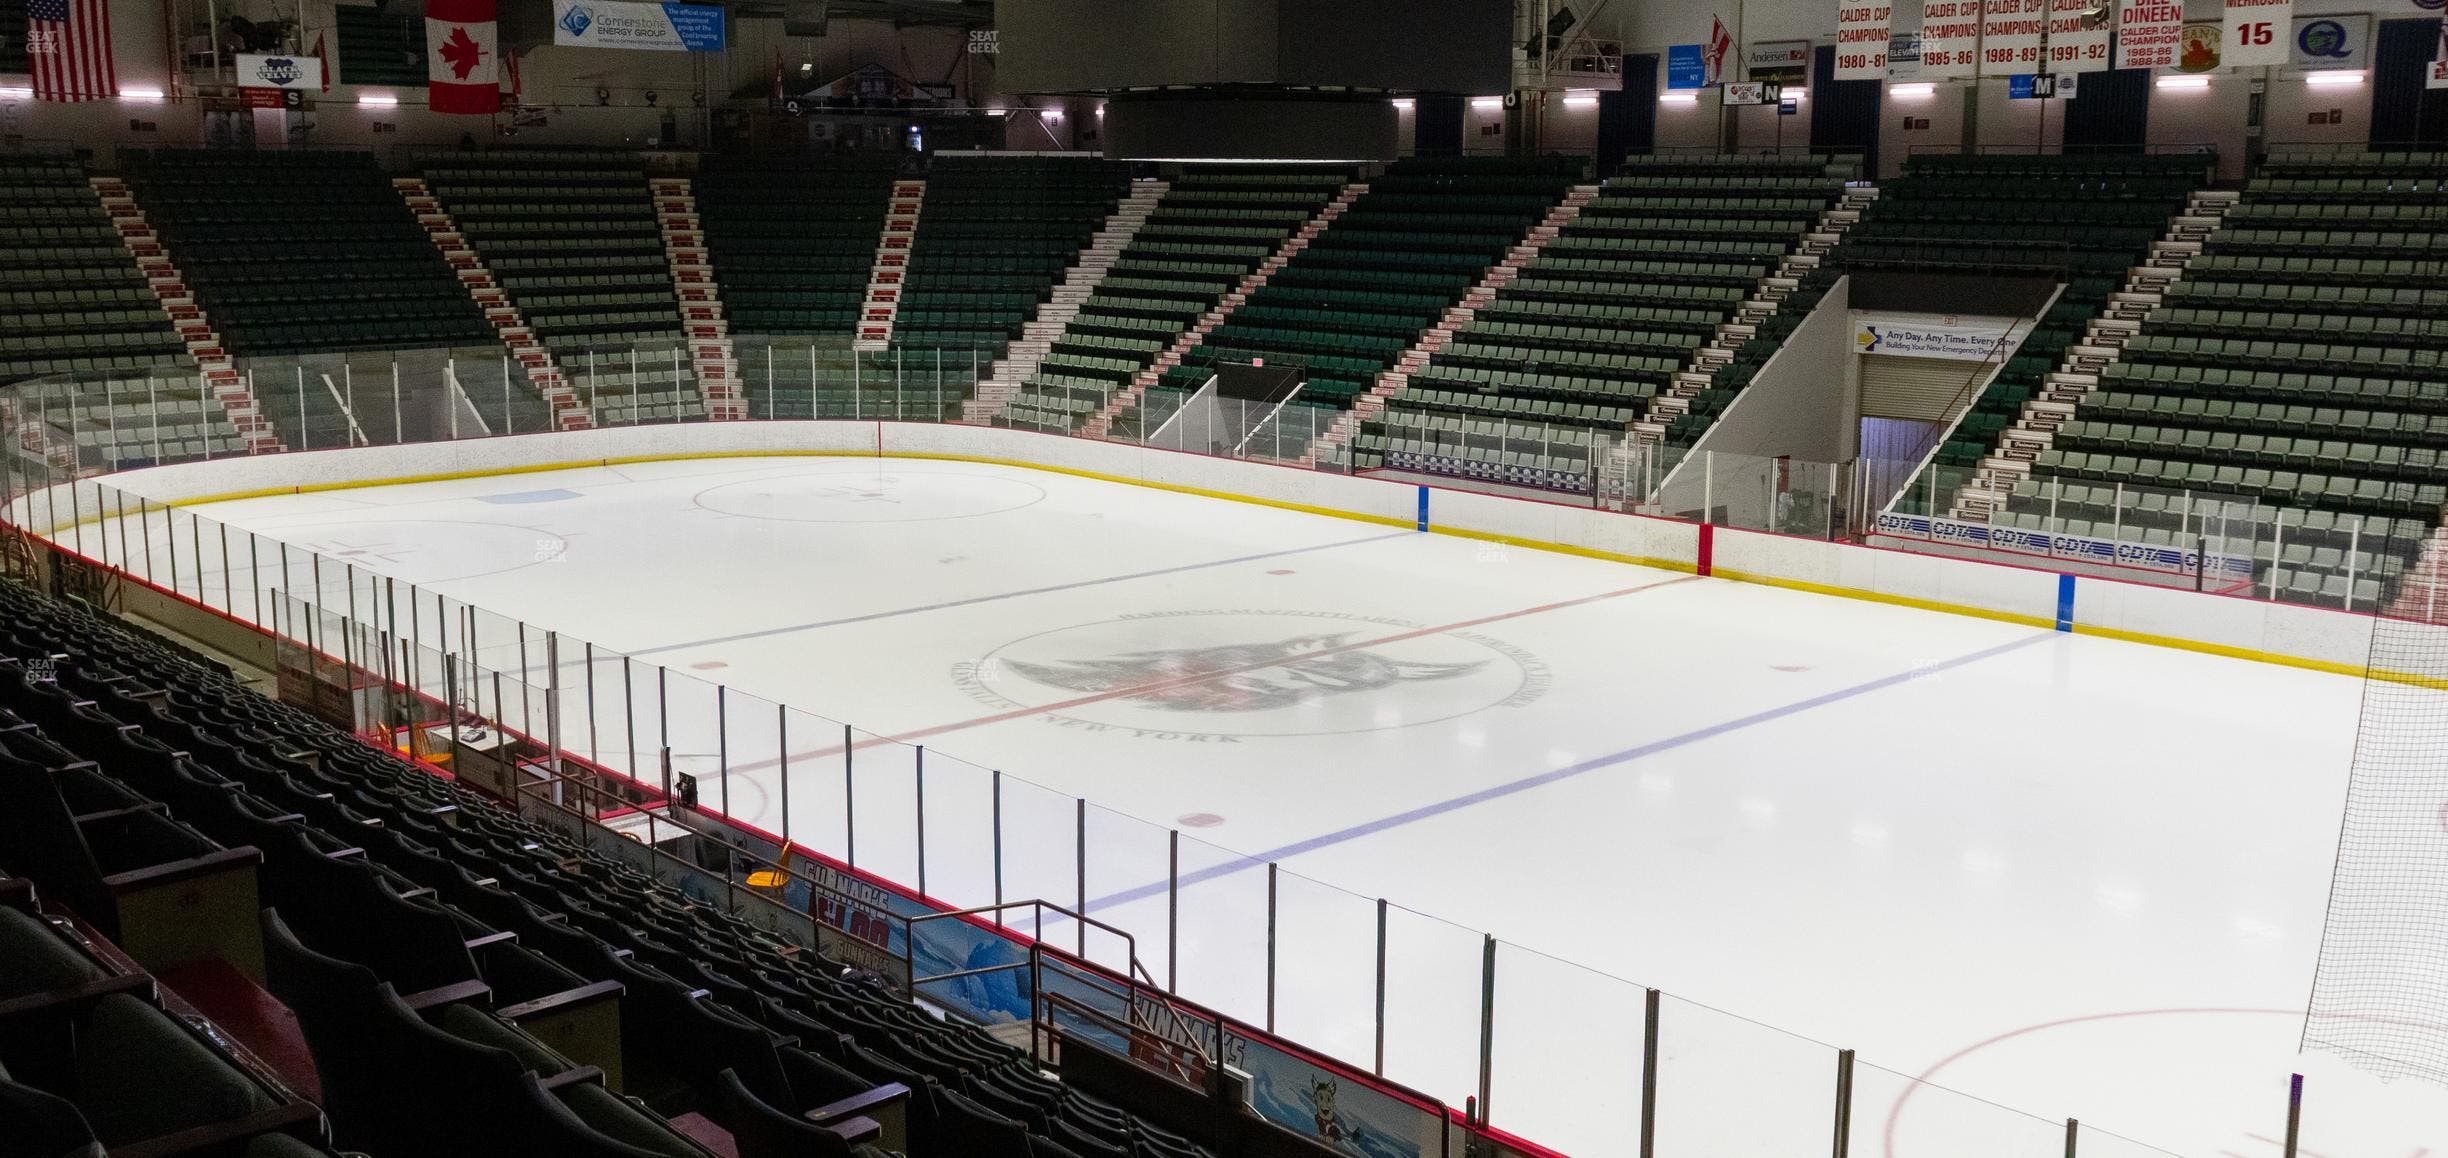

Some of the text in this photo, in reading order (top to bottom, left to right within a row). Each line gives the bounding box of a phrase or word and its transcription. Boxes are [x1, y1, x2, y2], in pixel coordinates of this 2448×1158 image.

[1925, 1, 1978, 18] CALDER CUP
[1986, 0, 2042, 14] CALDER CUP
[2051, 0, 2086, 12] CALDER
[597, 14, 666, 29] Cornerstone
[1839, 7, 1890, 22] CALDER CUP
[2123, 6, 2181, 24] DINEEN
[597, 28, 666, 37] ENERGY GROUP
[1838, 28, 1889, 43] CHAMPIONS
[1923, 23, 1977, 39] CHAMPIONS
[1985, 20, 2041, 36] CHAMPIONS
[2120, 25, 2181, 36] CALDER CUP
[2237, 22, 2273, 45] 15
[2120, 35, 2180, 46] CHAMPION
[1751, 51, 1788, 62] Andersen
[2126, 47, 2172, 56] 1985-86
[260, 64, 301, 73] BLACK
[2126, 56, 2171, 66] 1988-89
[256, 71, 303, 80] VELVET
[1765, 85, 1778, 100] N
[2035, 77, 2052, 94] M
[287, 92, 299, 105] S
[1886, 330, 1904, 341] Any
[1905, 332, 1923, 343] Day.
[1926, 333, 1942, 344] Any
[1944, 334, 1969, 345] Time.
[1971, 336, 1995, 347] Every
[1886, 342, 1911, 351] Building
[1911, 343, 1926, 351] Your
[1926, 344, 1942, 352] New
[1942, 345, 1977, 355] Emergency
[1878, 514, 1914, 530] CDTA
[1933, 521, 1971, 536] CDTA
[1992, 528, 2032, 545] CDTA
[2053, 537, 2095, 553] CDTA
[2118, 544, 2160, 561] CDTA
